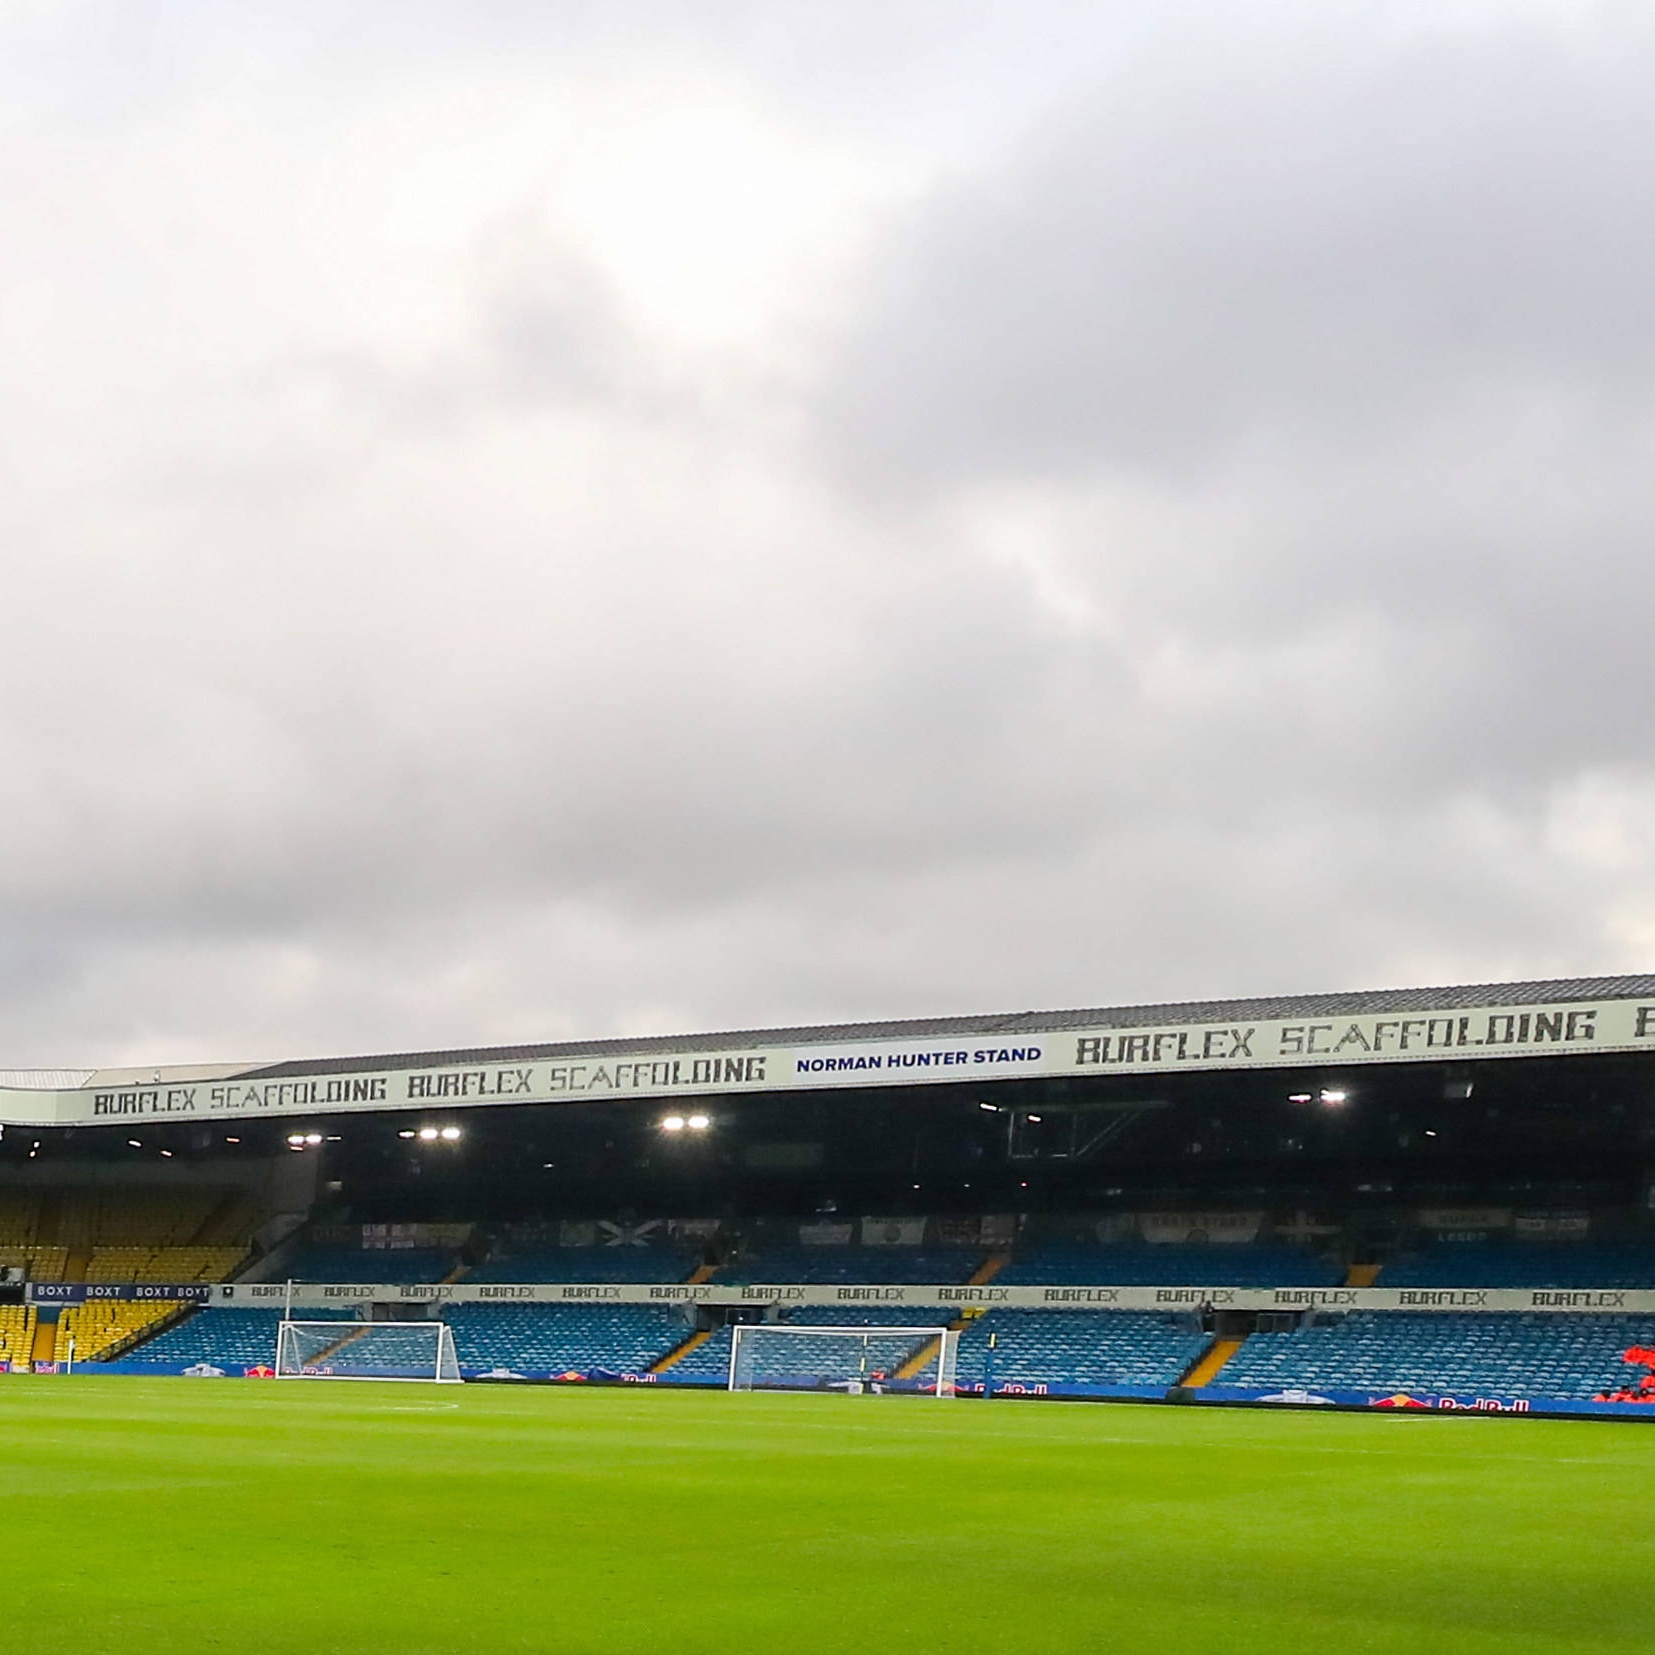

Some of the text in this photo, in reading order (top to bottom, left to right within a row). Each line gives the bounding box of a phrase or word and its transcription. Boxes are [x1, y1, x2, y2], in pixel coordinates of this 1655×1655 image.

[1075, 1028, 1256, 1065] BURFLEX
[1280, 1009, 1597, 1056] SCAFFOLDING
[407, 1056, 768, 1100] BURFLEX SCAFFOLDING
[796, 1046, 1043, 1073] NORMAN HUNTER STAND
[93, 1076, 387, 1116] BURFLEX SCAFFOLDING
[38, 1286, 73, 1296] BOXT
[86, 1286, 121, 1296] BOXT
[136, 1287, 171, 1297] BOXT
